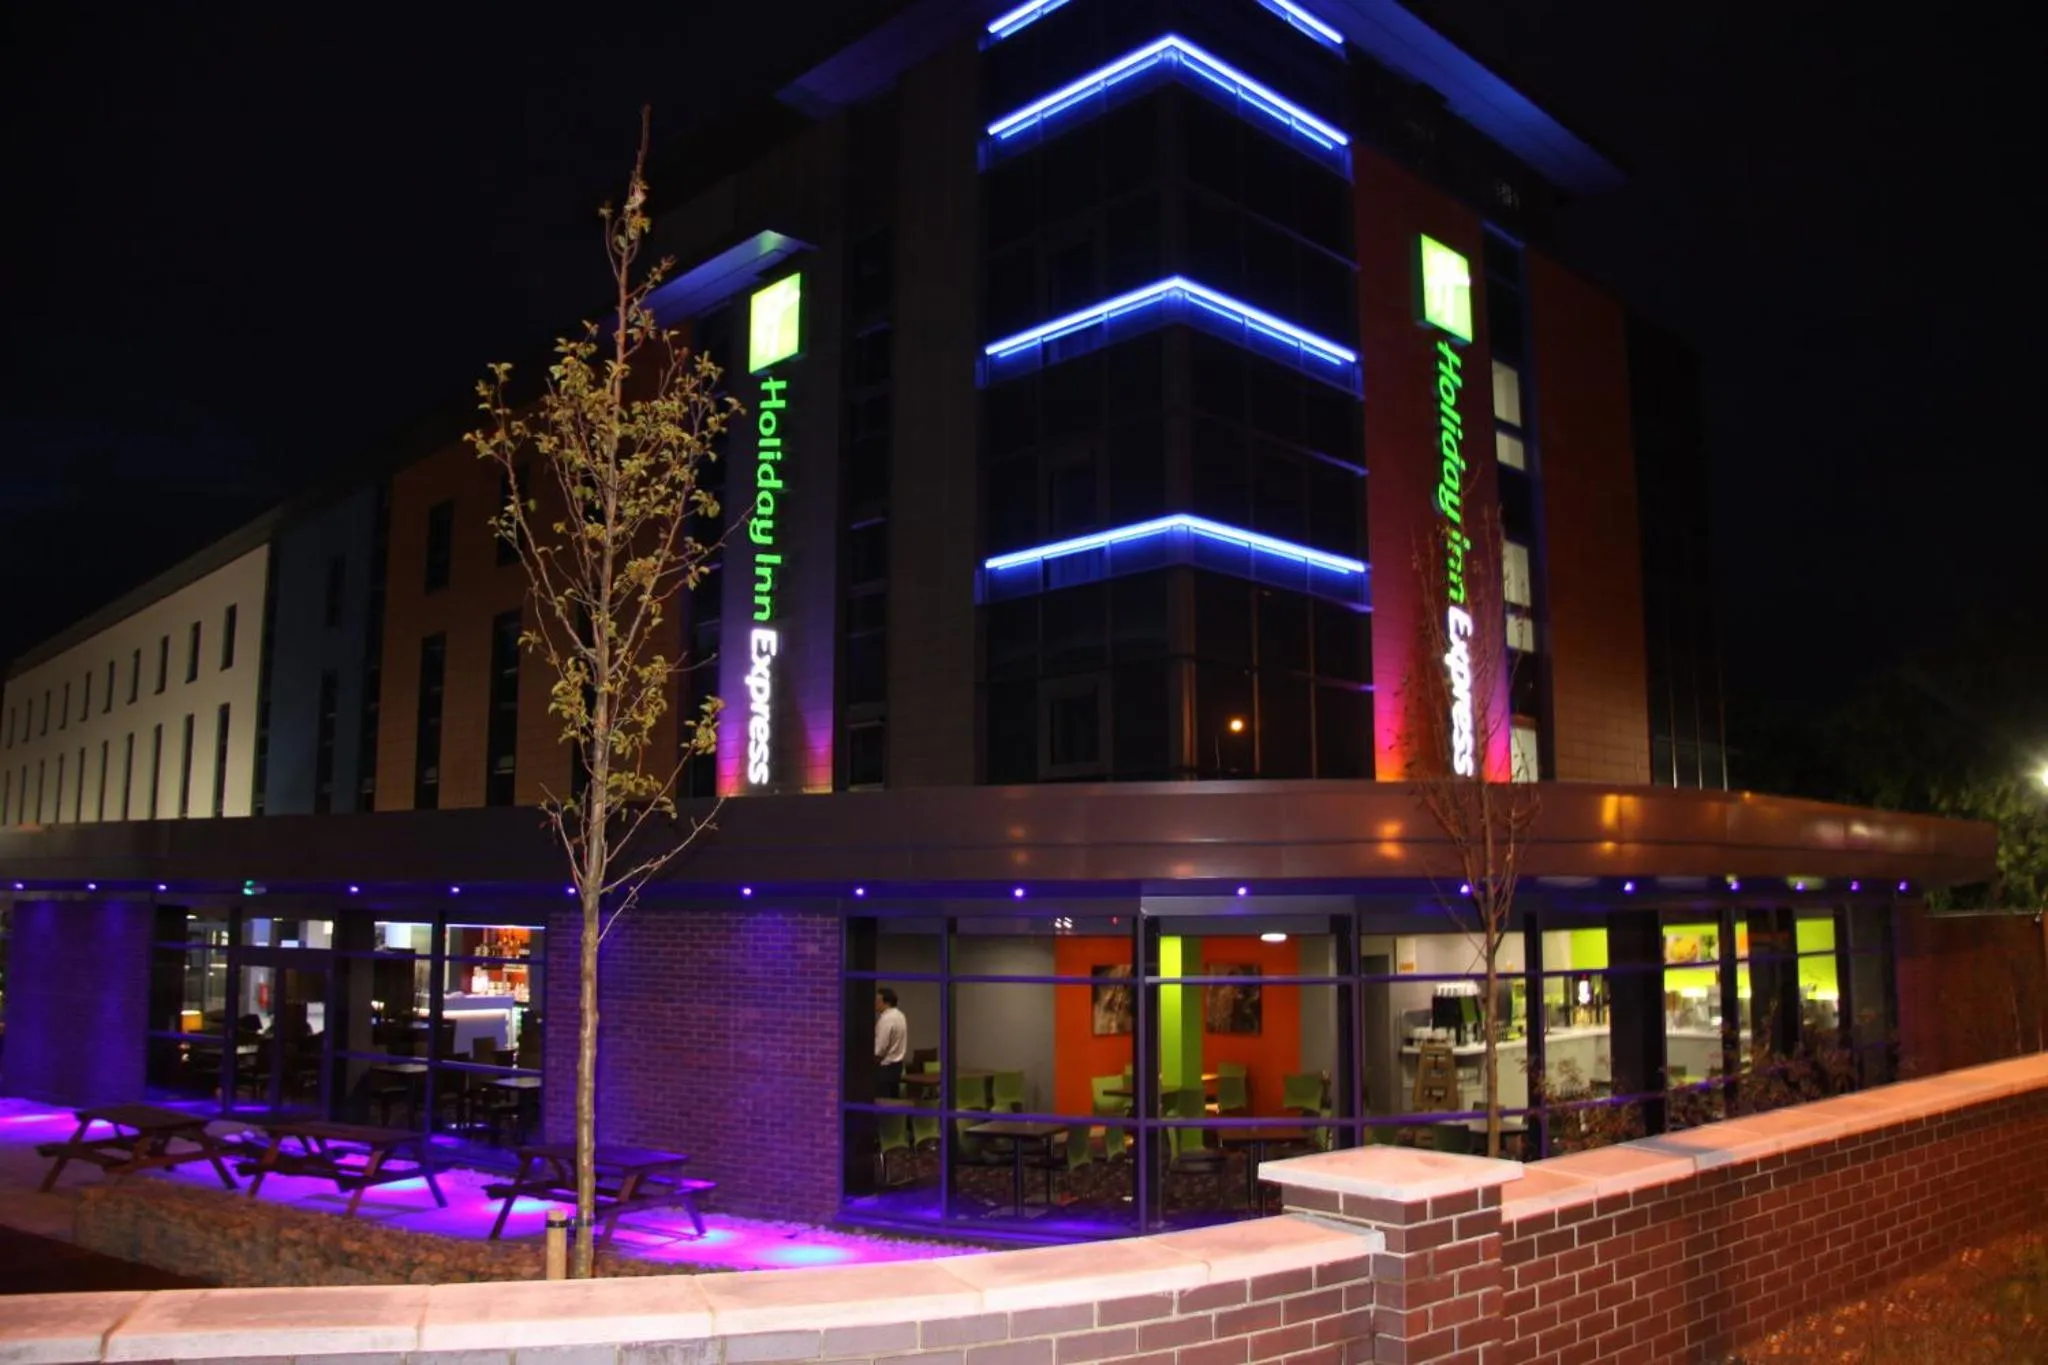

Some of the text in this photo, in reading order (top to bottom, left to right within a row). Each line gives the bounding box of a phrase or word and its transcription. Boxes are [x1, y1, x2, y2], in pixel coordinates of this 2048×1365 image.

[749, 376, 787, 545] Holiday
[1437, 340, 1466, 524] Holiday
[753, 554, 782, 621] Inn
[745, 628, 777, 784] Express
[1444, 605, 1474, 777] Express
